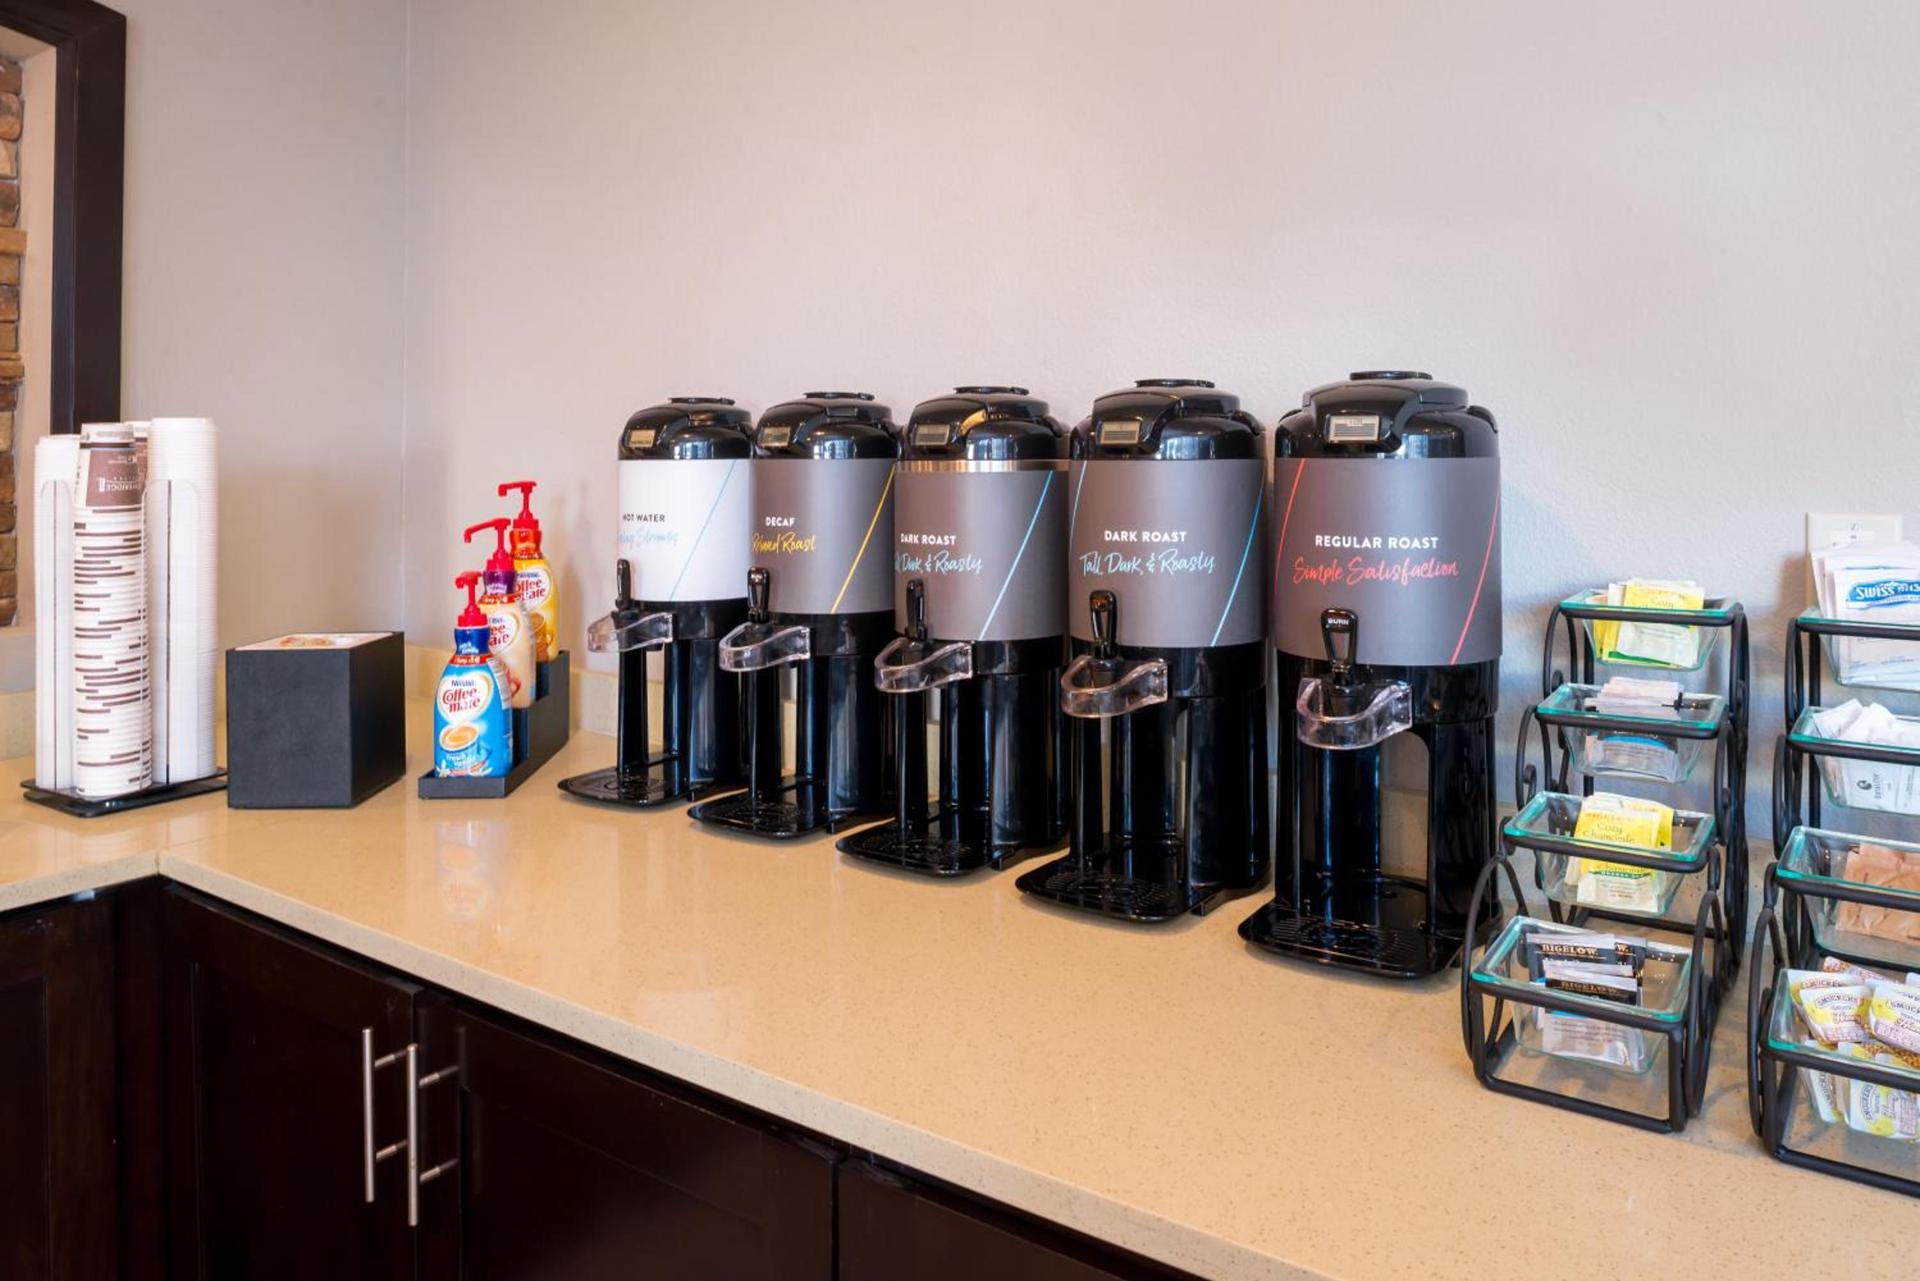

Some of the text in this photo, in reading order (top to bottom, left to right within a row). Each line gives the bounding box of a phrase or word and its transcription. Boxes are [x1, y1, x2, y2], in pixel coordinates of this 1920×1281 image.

[636, 514, 665, 522] WATER
[765, 516, 796, 527] DECAF
[900, 533, 957, 545] DARK ROAST
[1103, 530, 1187, 542] DARK ROAST
[1315, 535, 1439, 549] REGULAR ROAST
[1158, 548, 1215, 575] Roasty
[1292, 555, 1459, 586] Simple Satisfaction
[515, 579, 543, 595] offee
[1855, 585, 1895, 600] SWISS
[489, 634, 510, 647] ate
[1541, 944, 1598, 956] BIGELOW
